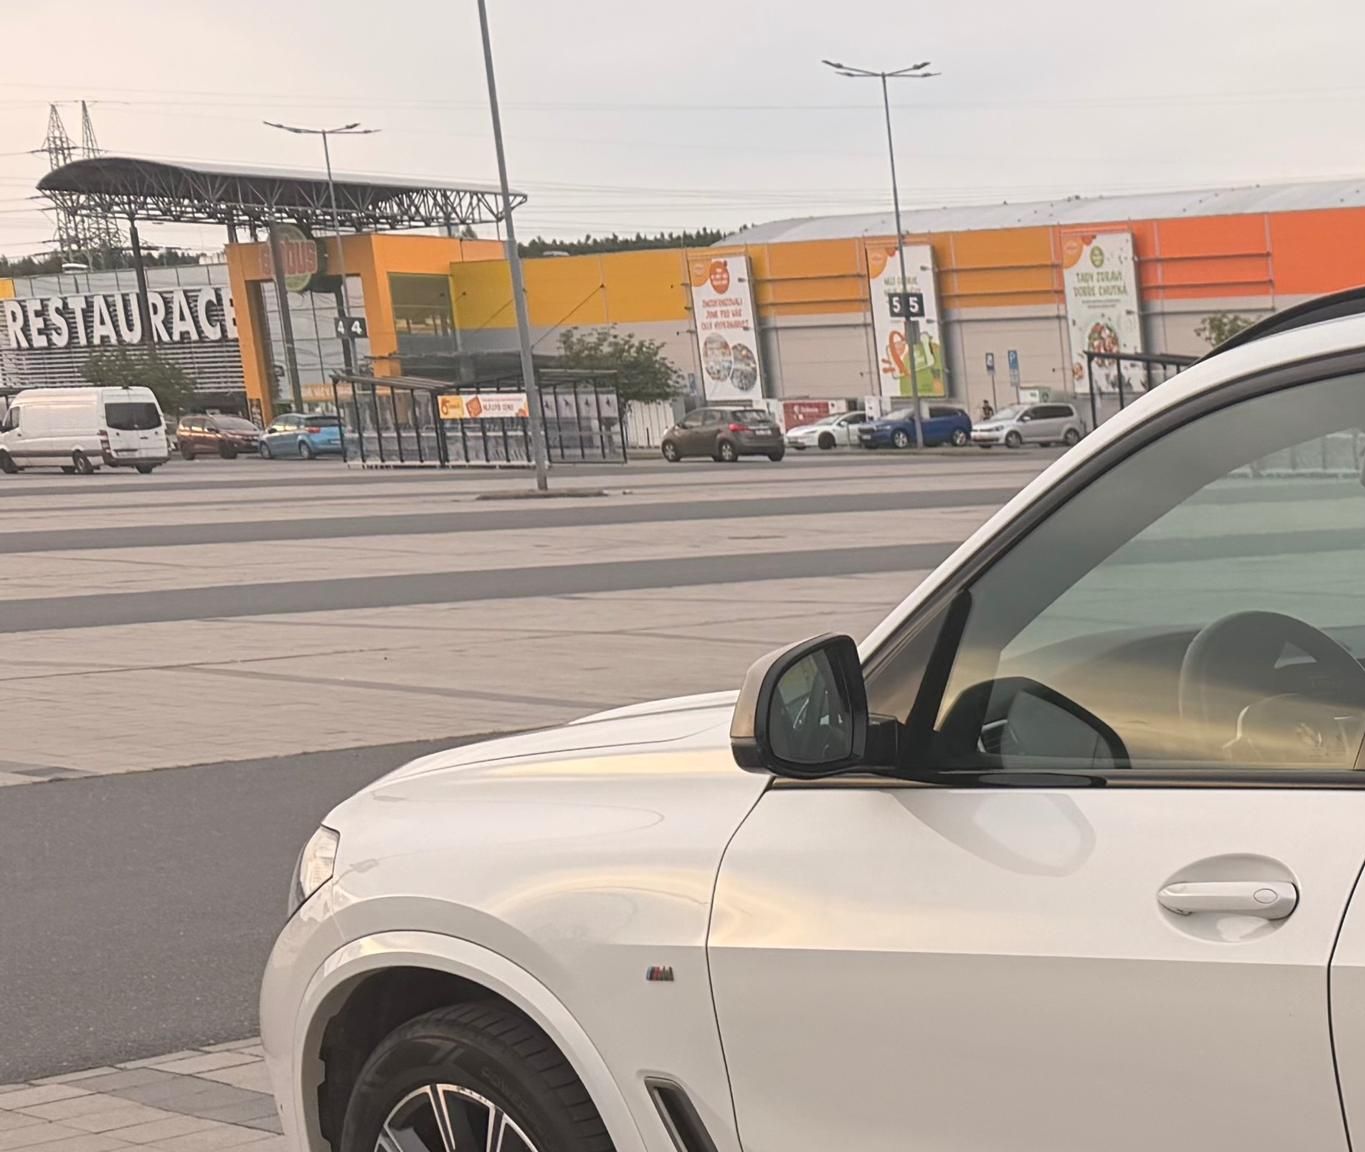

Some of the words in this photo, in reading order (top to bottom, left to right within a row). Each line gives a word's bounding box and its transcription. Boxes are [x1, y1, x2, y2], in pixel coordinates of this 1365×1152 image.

[892, 296, 901, 313] 5
[909, 296, 919, 313] 5
[4, 286, 239, 349] RESTAURACE
[337, 320, 345, 334] 4
[351, 320, 362, 335] 4
